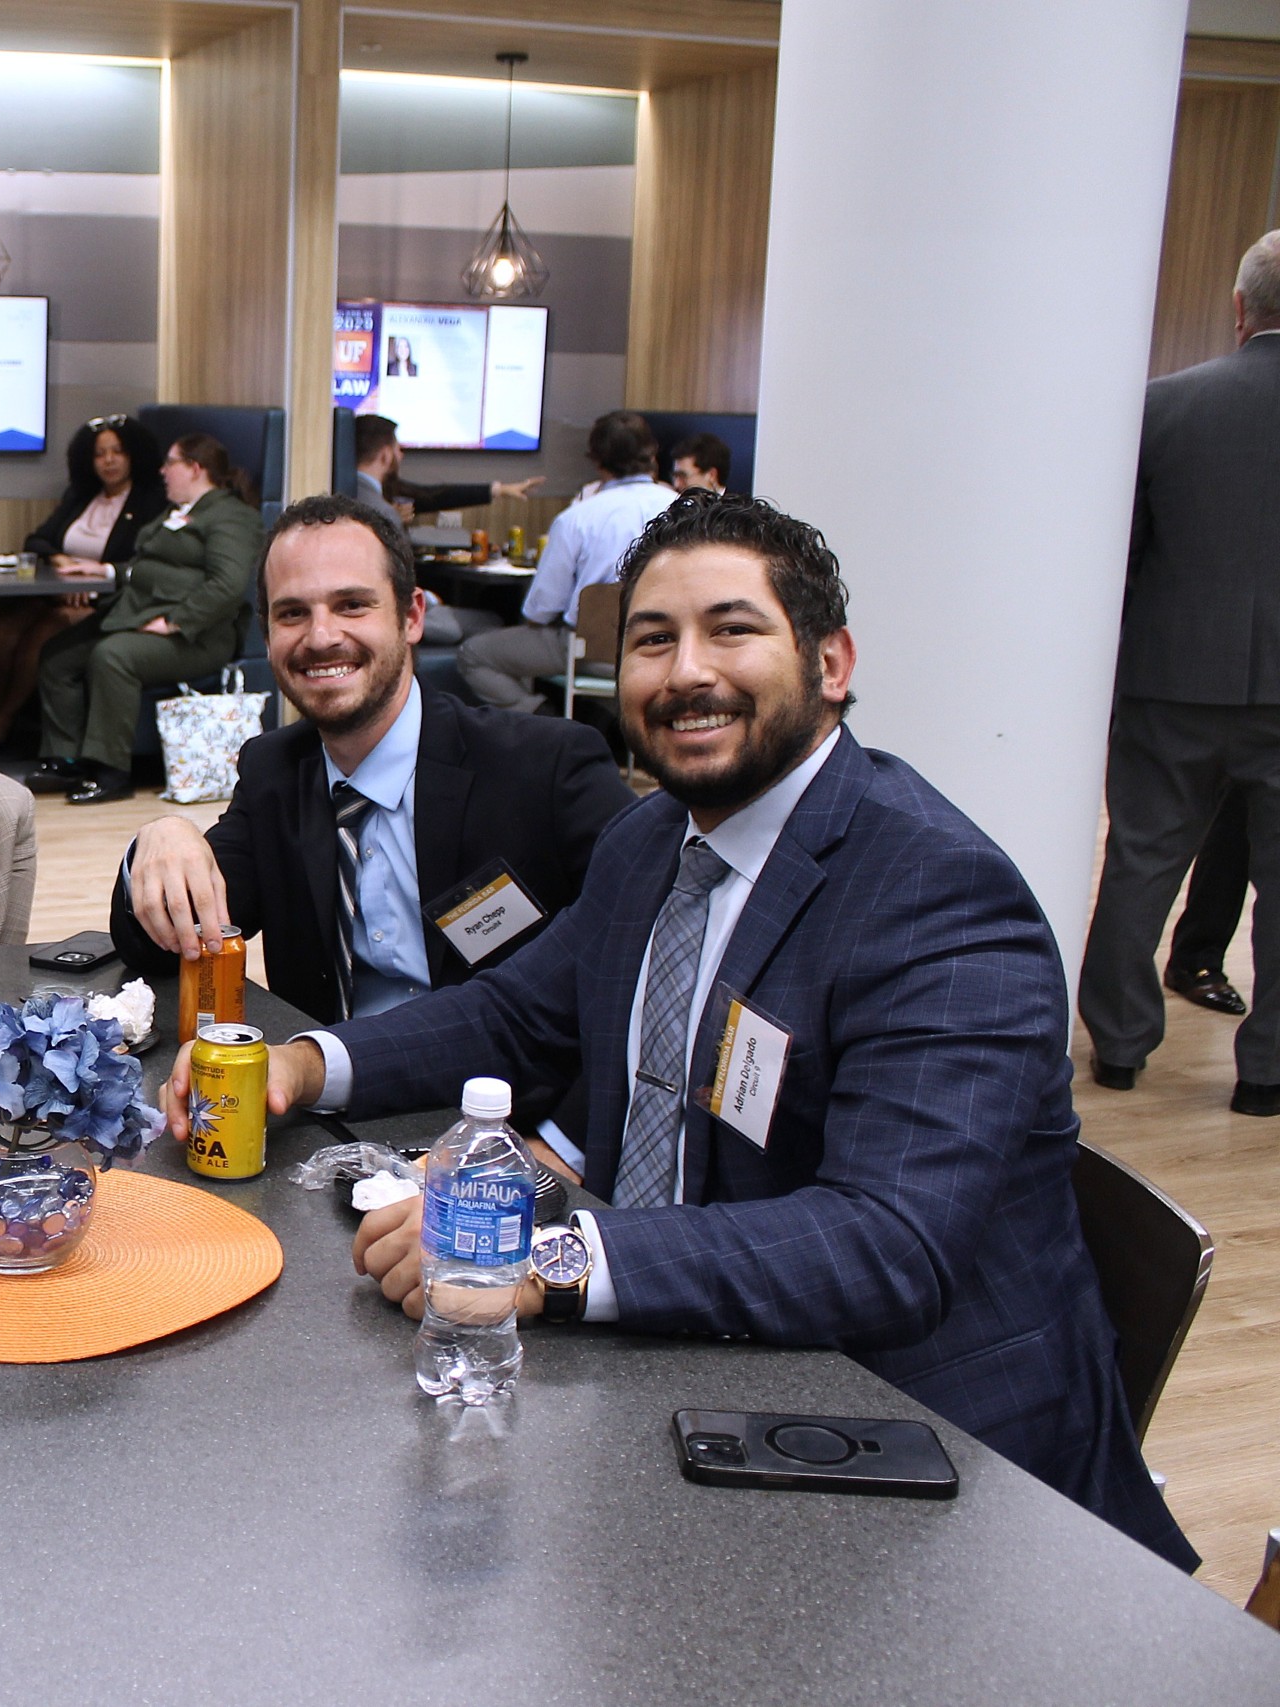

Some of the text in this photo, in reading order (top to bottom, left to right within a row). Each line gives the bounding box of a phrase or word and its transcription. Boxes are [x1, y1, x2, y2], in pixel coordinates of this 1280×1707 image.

[338, 341, 367, 363] UF
[333, 379, 370, 396] LAW
[458, 895, 484, 914] FLORIDA
[481, 886, 496, 898] BAR
[464, 920, 484, 935] Ryan
[714, 1025, 736, 1099] THE FLORIDA BAR
[734, 1037, 757, 1115] Adrian Delgado
[749, 1072, 761, 1097] Circuit
[187, 1131, 227, 1159] EGA
[207, 1159, 229, 1169] ALE
[457, 1199, 497, 1211] AQUAFINA
